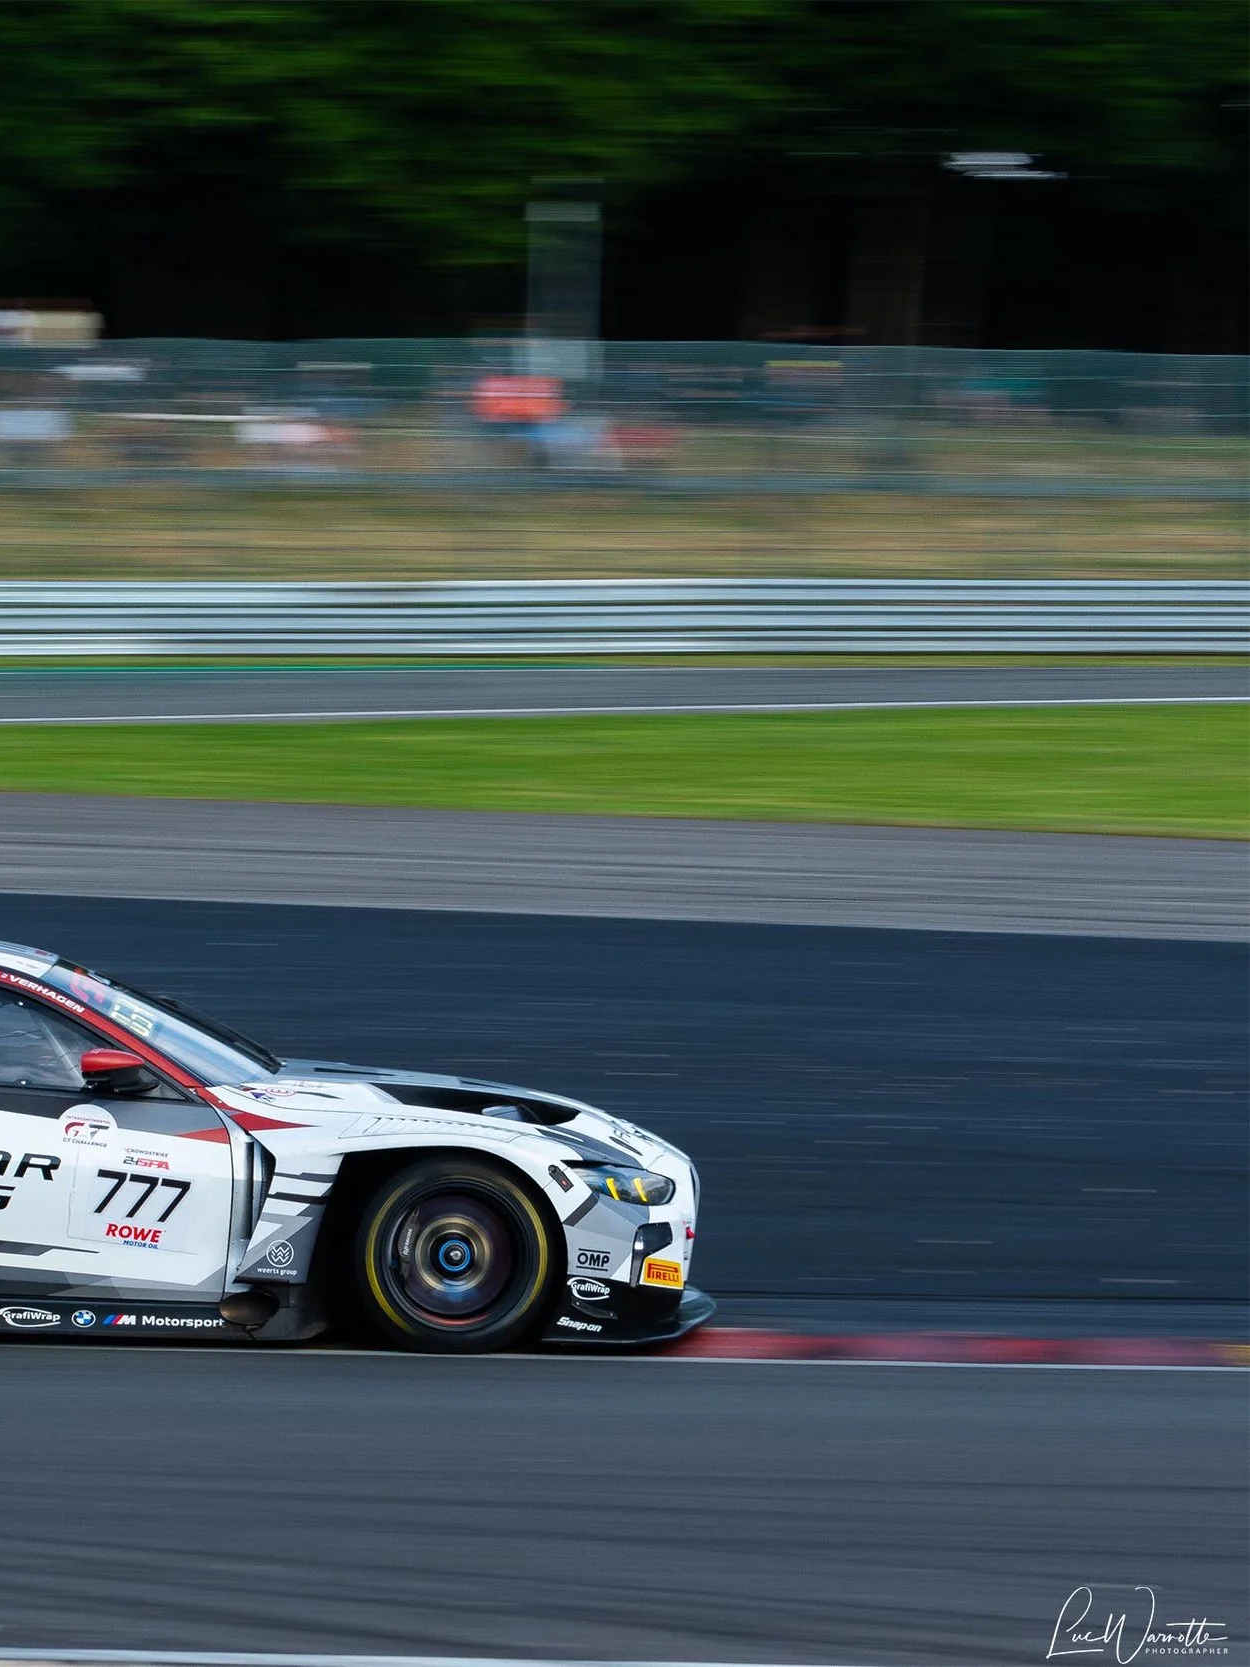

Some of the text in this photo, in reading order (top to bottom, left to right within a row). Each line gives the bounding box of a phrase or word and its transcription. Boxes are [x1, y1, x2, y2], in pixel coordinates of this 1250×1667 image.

[9, 974, 86, 1014] VERHAGEN
[72, 1138, 108, 1148] CHALLENGE
[126, 1148, 168, 1157] CROWDSTRIKE
[94, 1168, 192, 1223] 777
[105, 1223, 162, 1243] ROWE
[123, 1240, 147, 1249] MOTOR
[577, 1252, 610, 1268] OMP
[647, 1262, 680, 1282] PIRELLI
[570, 1281, 610, 1296] GrafiWrap
[2, 1310, 61, 1322] GrafiWrap
[141, 1314, 226, 1329] Motorsport
[556, 1316, 602, 1333] Snap-on
